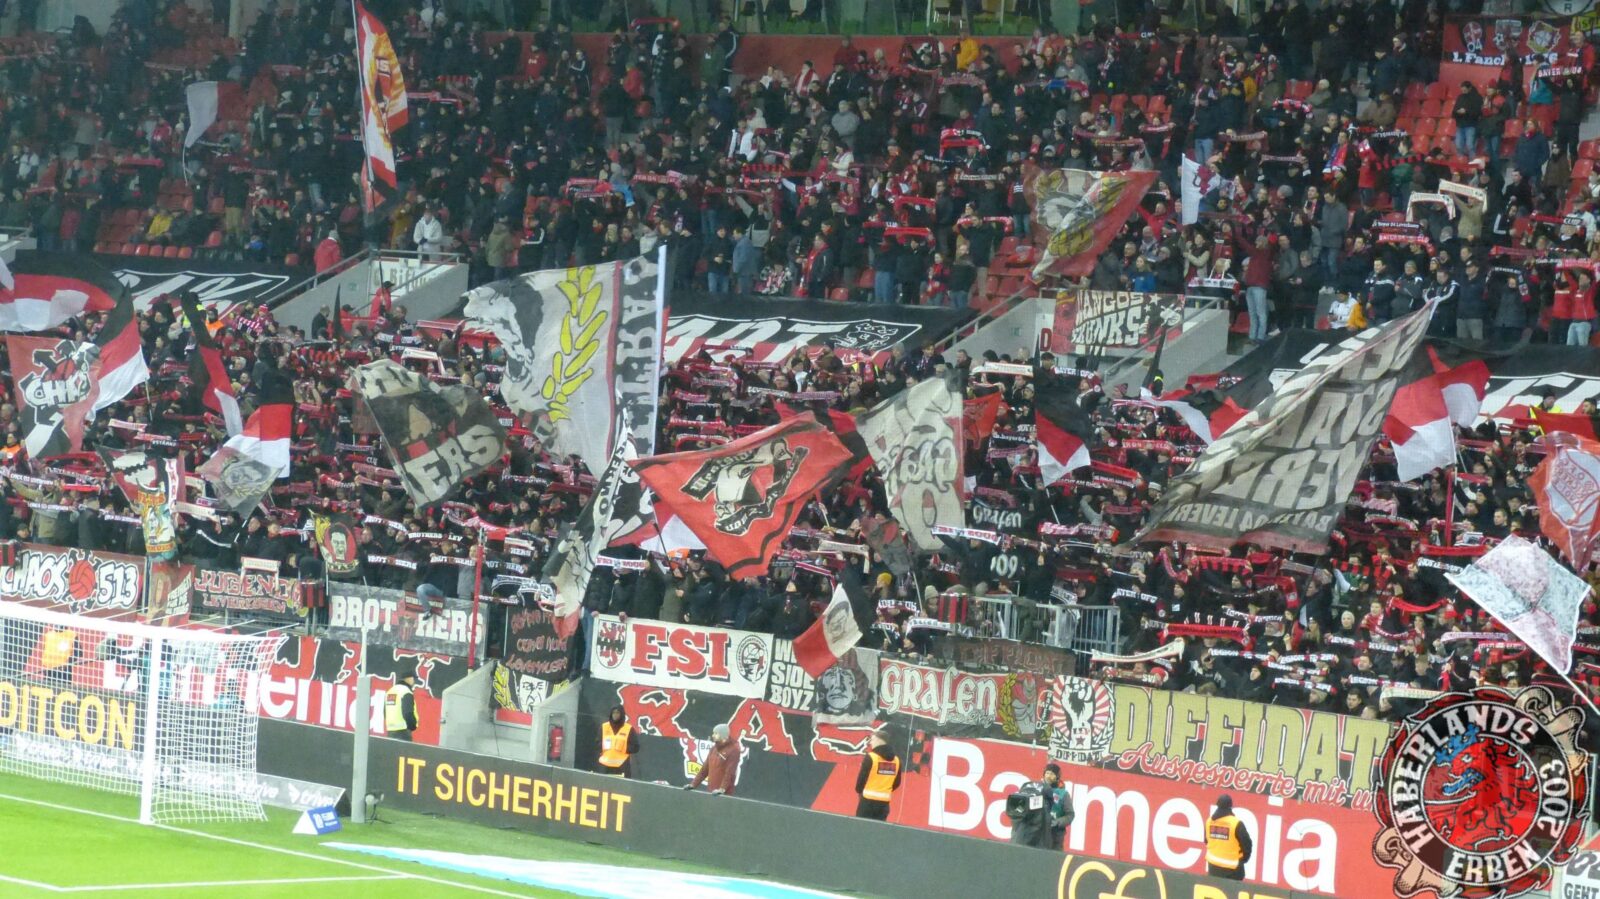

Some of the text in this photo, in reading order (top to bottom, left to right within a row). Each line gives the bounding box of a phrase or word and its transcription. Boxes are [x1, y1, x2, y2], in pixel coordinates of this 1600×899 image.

[98, 562, 139, 606] 513
[331, 595, 398, 633] BROT
[630, 623, 731, 684] FSI
[769, 684, 814, 711] BOYZ
[771, 661, 816, 691] SIDE
[1118, 742, 1296, 799] Ausgesperrte
[397, 756, 632, 833] IT SICHERHEIT
